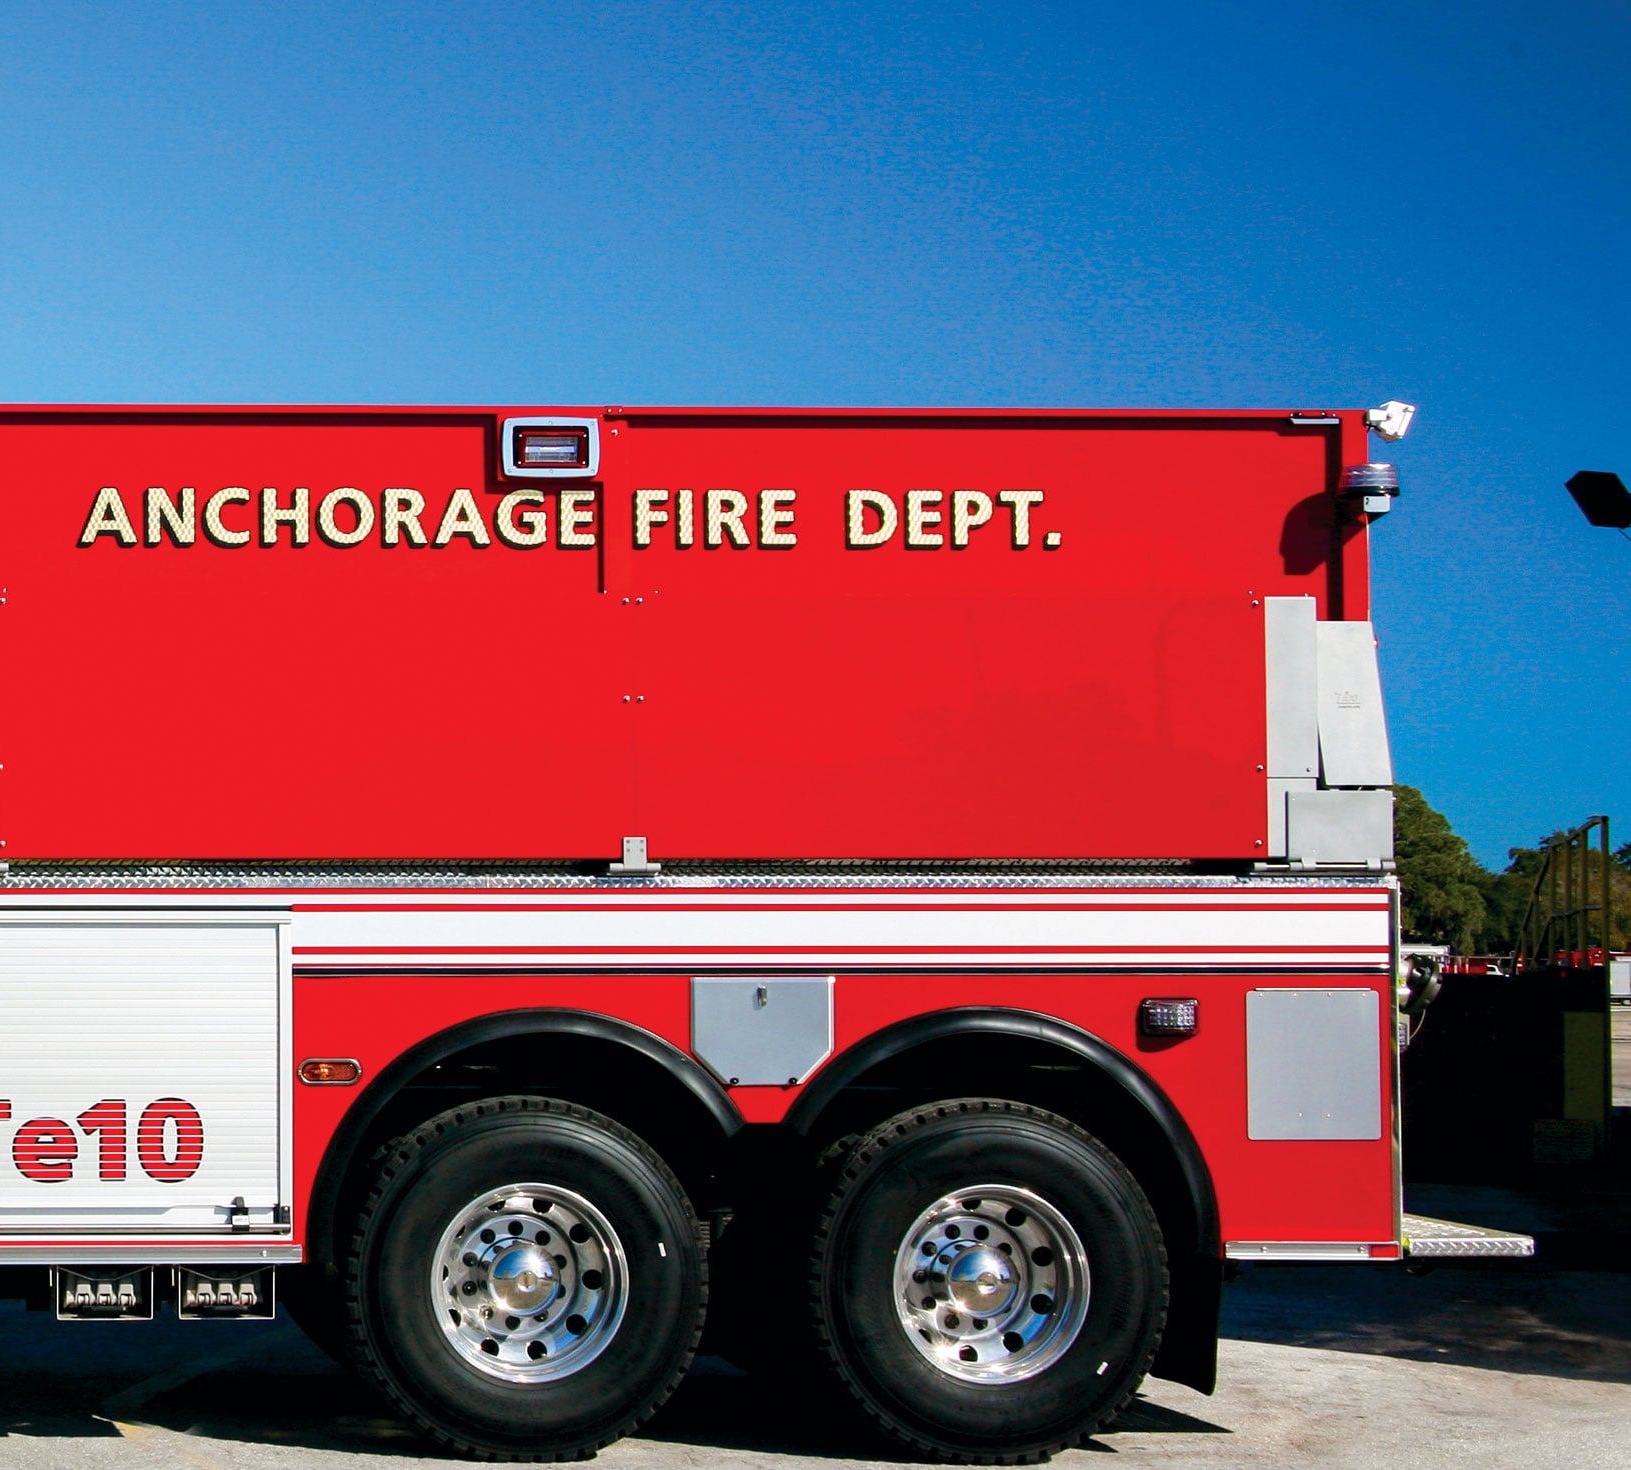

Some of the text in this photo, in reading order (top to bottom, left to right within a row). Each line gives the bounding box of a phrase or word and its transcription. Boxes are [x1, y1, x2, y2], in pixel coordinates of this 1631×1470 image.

[78, 487, 1063, 549] ANCHORAGE FIRE DEPT.
